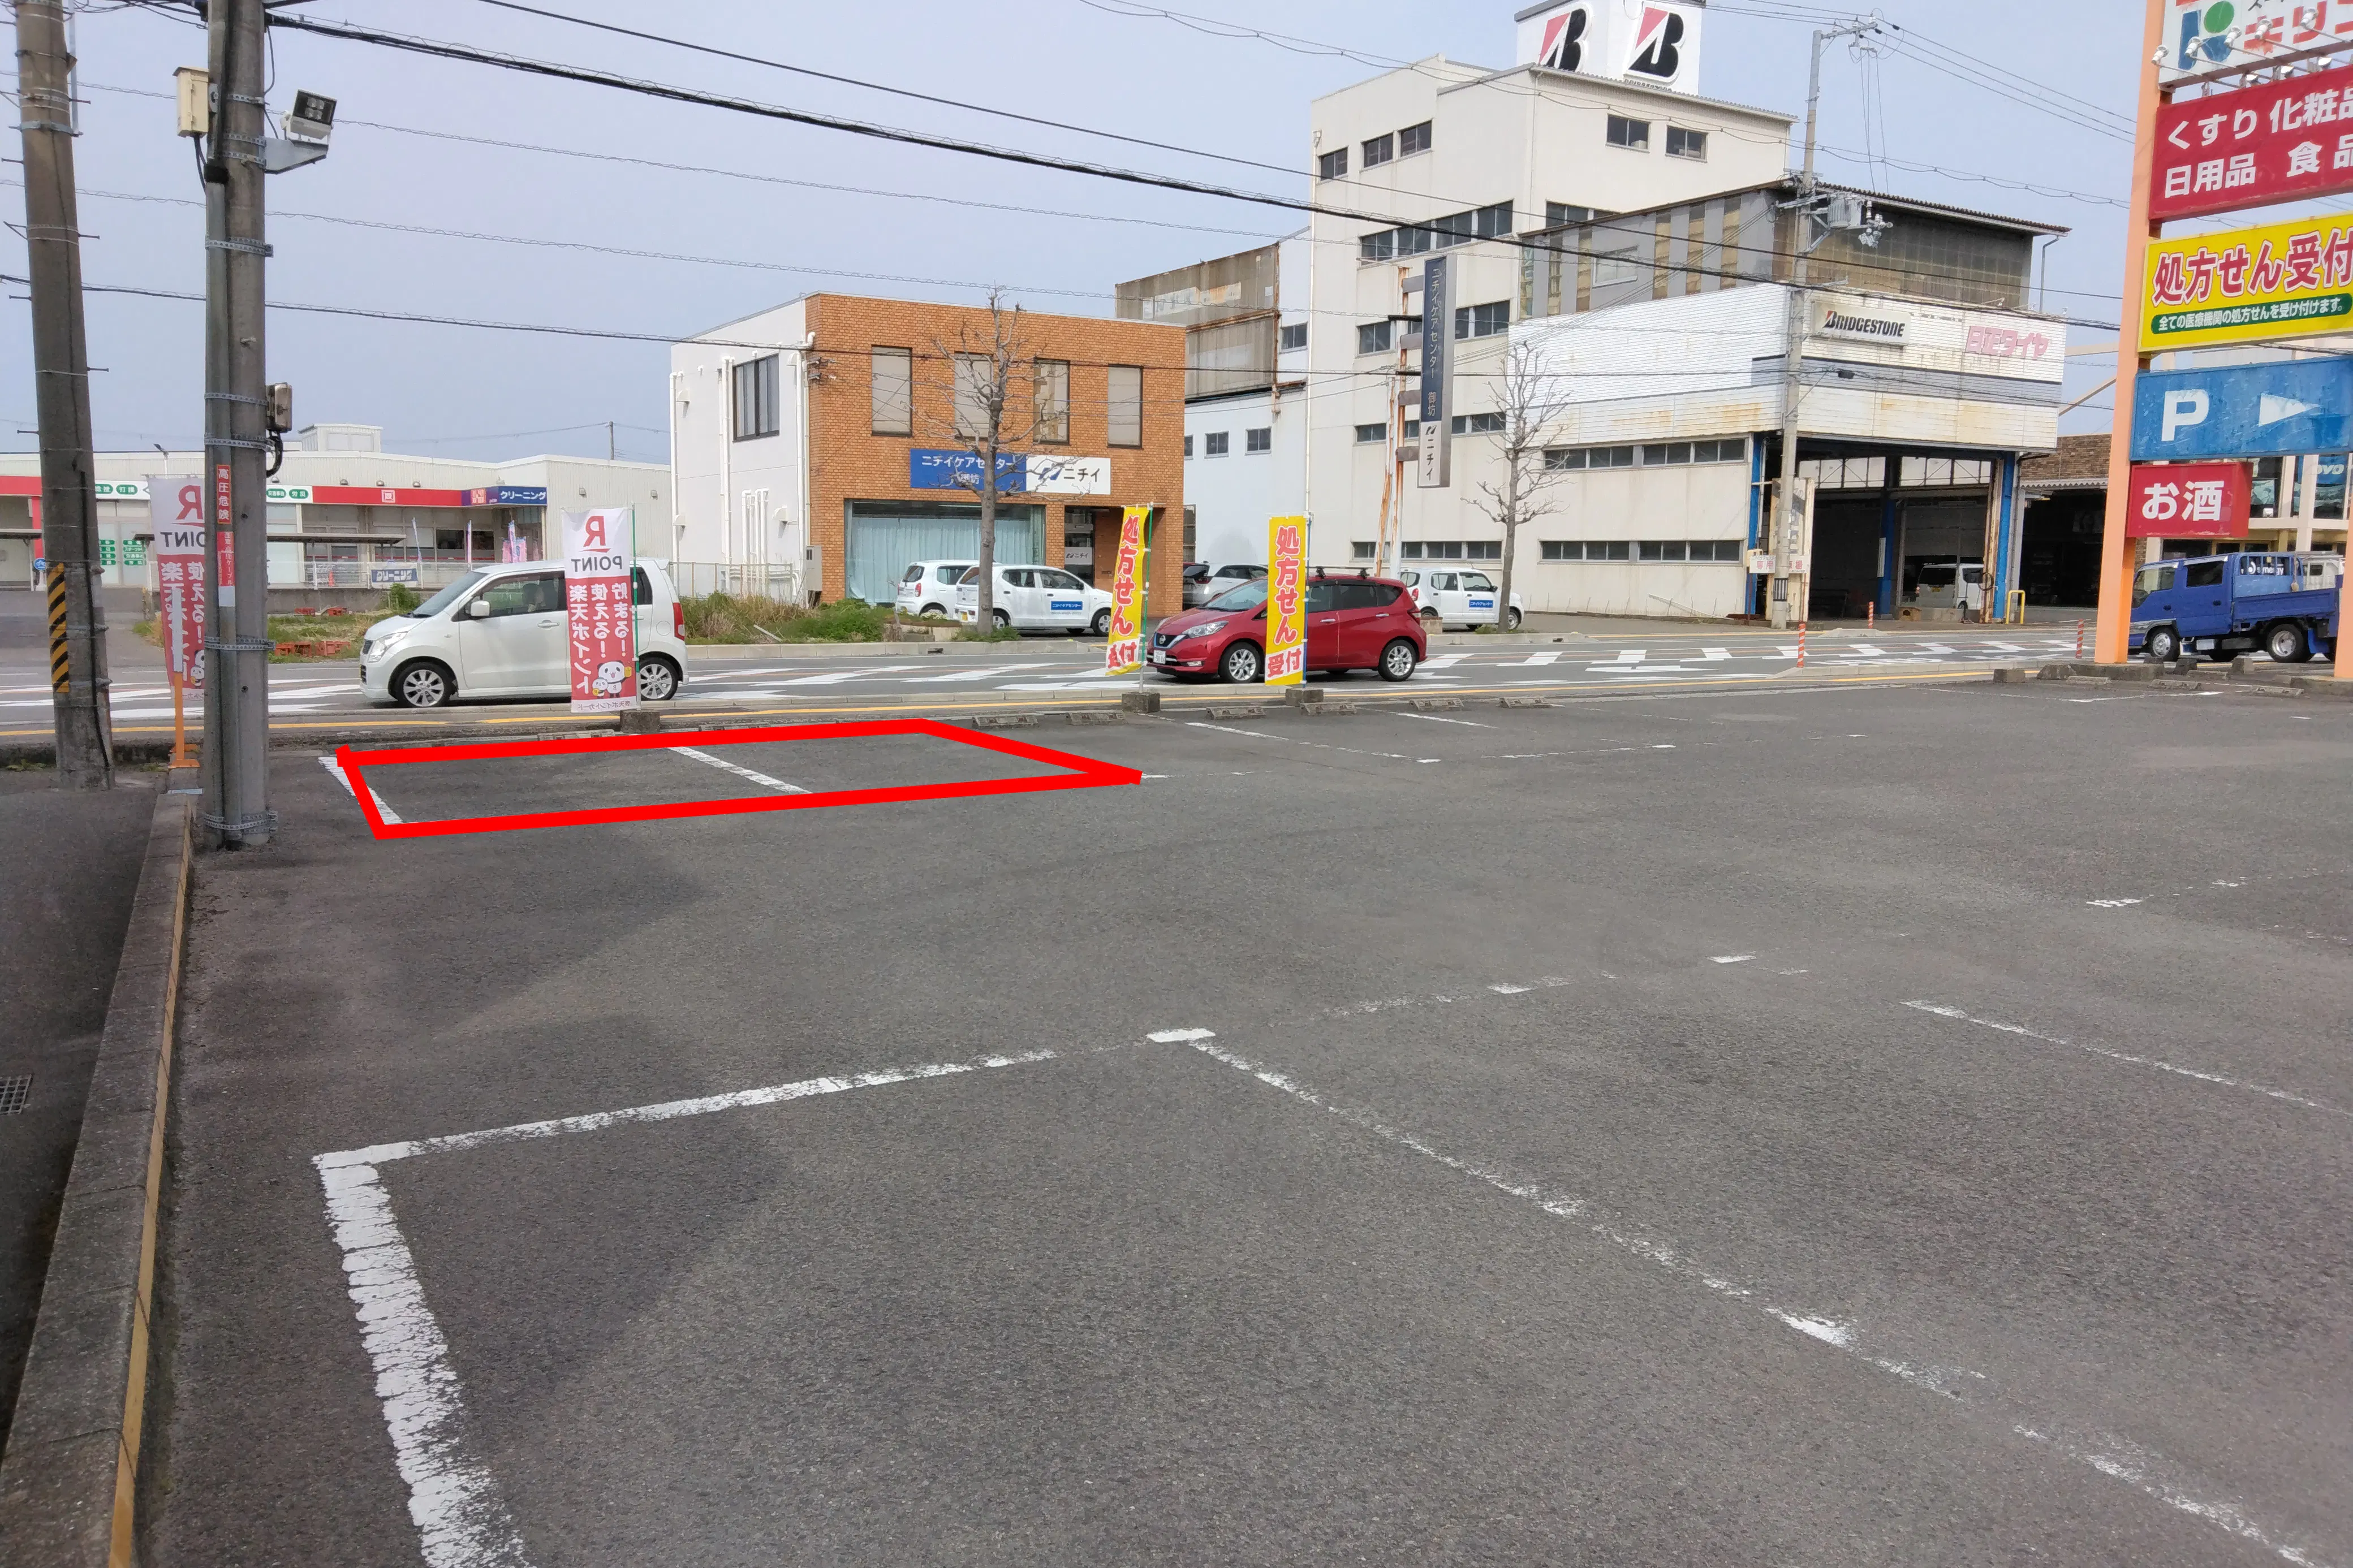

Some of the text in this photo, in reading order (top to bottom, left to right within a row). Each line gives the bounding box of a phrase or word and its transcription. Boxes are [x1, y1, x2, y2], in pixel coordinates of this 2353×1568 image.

[2168, 109, 2257, 149] くすり
[2165, 153, 2256, 198] 日用品
[2151, 227, 2353, 307] 処方せん受付
[1822, 310, 1906, 338] BRIDGESTONE
[2158, 297, 2344, 332] 全ての医療機関の処方せんを受け付けます。
[1427, 268, 1441, 417] ニチイケアセンター 御坊
[2161, 389, 2209, 442] P
[921, 455, 1017, 469] ニチイケアセター
[1064, 468, 1101, 482] ニチイ
[1425, 439, 1435, 481] ニチイ
[218, 469, 230, 520] 高圧危険
[500, 490, 546, 500] クリーニング
[2142, 481, 2225, 521] お酒
[1111, 514, 1140, 637] 処方せん
[1274, 525, 1300, 646] 処方せん
[1268, 648, 1302, 678] 受付
